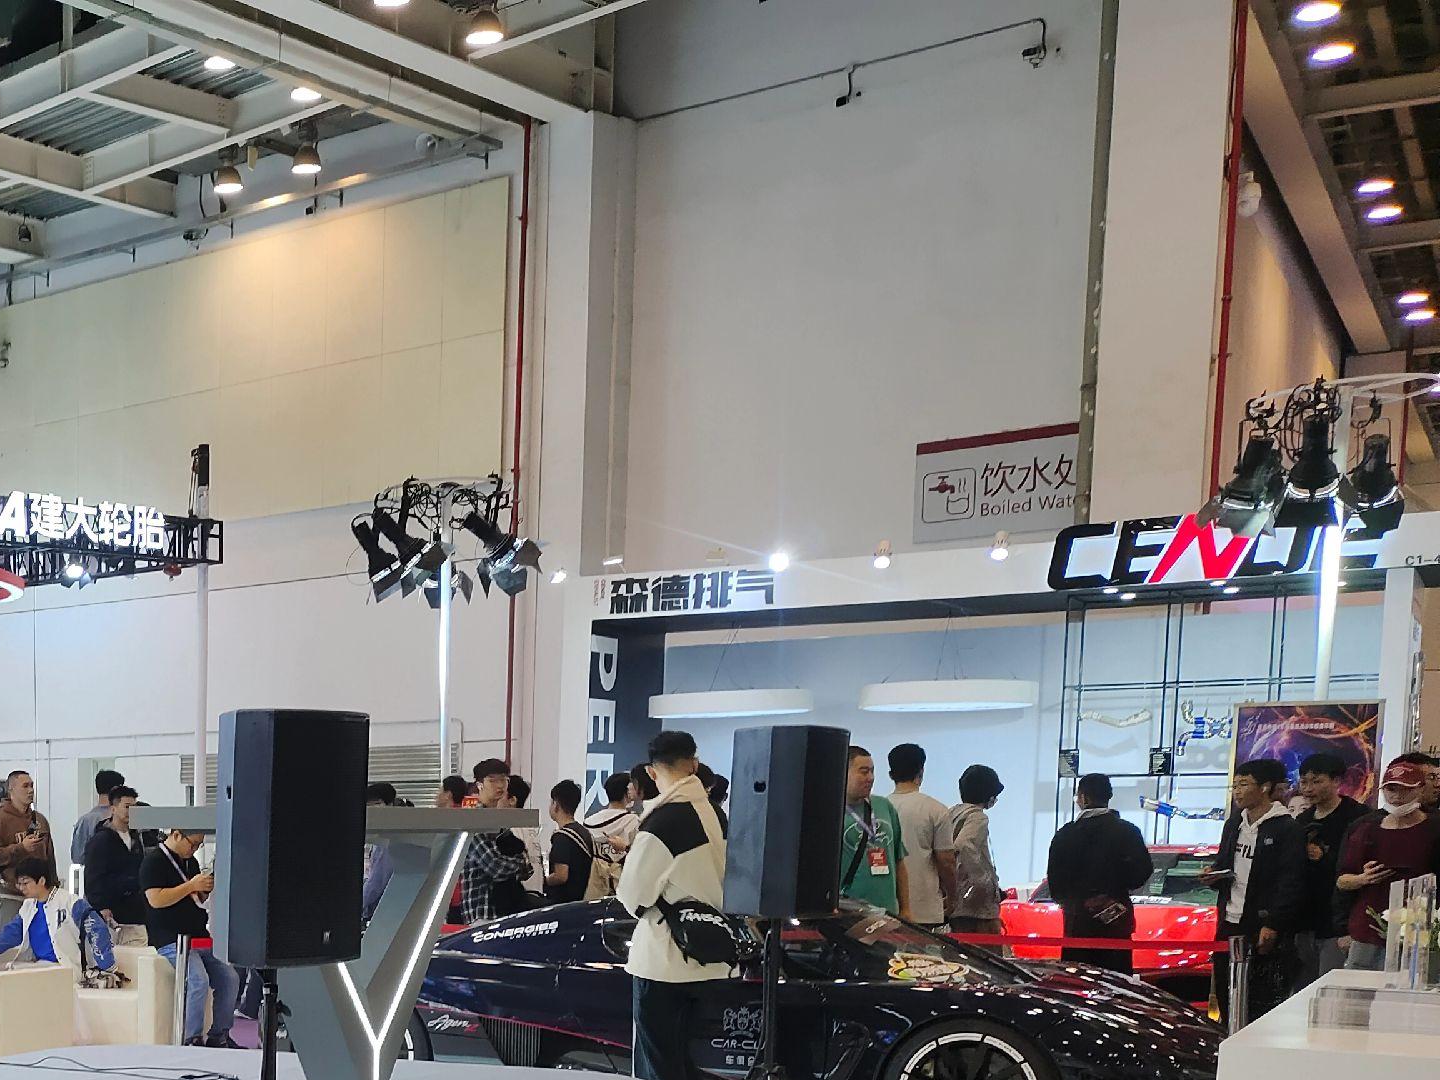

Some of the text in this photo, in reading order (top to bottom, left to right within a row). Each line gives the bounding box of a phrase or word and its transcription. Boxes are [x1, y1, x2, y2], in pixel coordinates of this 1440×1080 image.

[980, 496, 1032, 517] Boiled
[27, 492, 168, 552] 建大轮胎
[610, 569, 776, 615] 森德排气
[473, 920, 559, 944] CONERGIES
[711, 1038, 766, 1050] CAR-CLU
